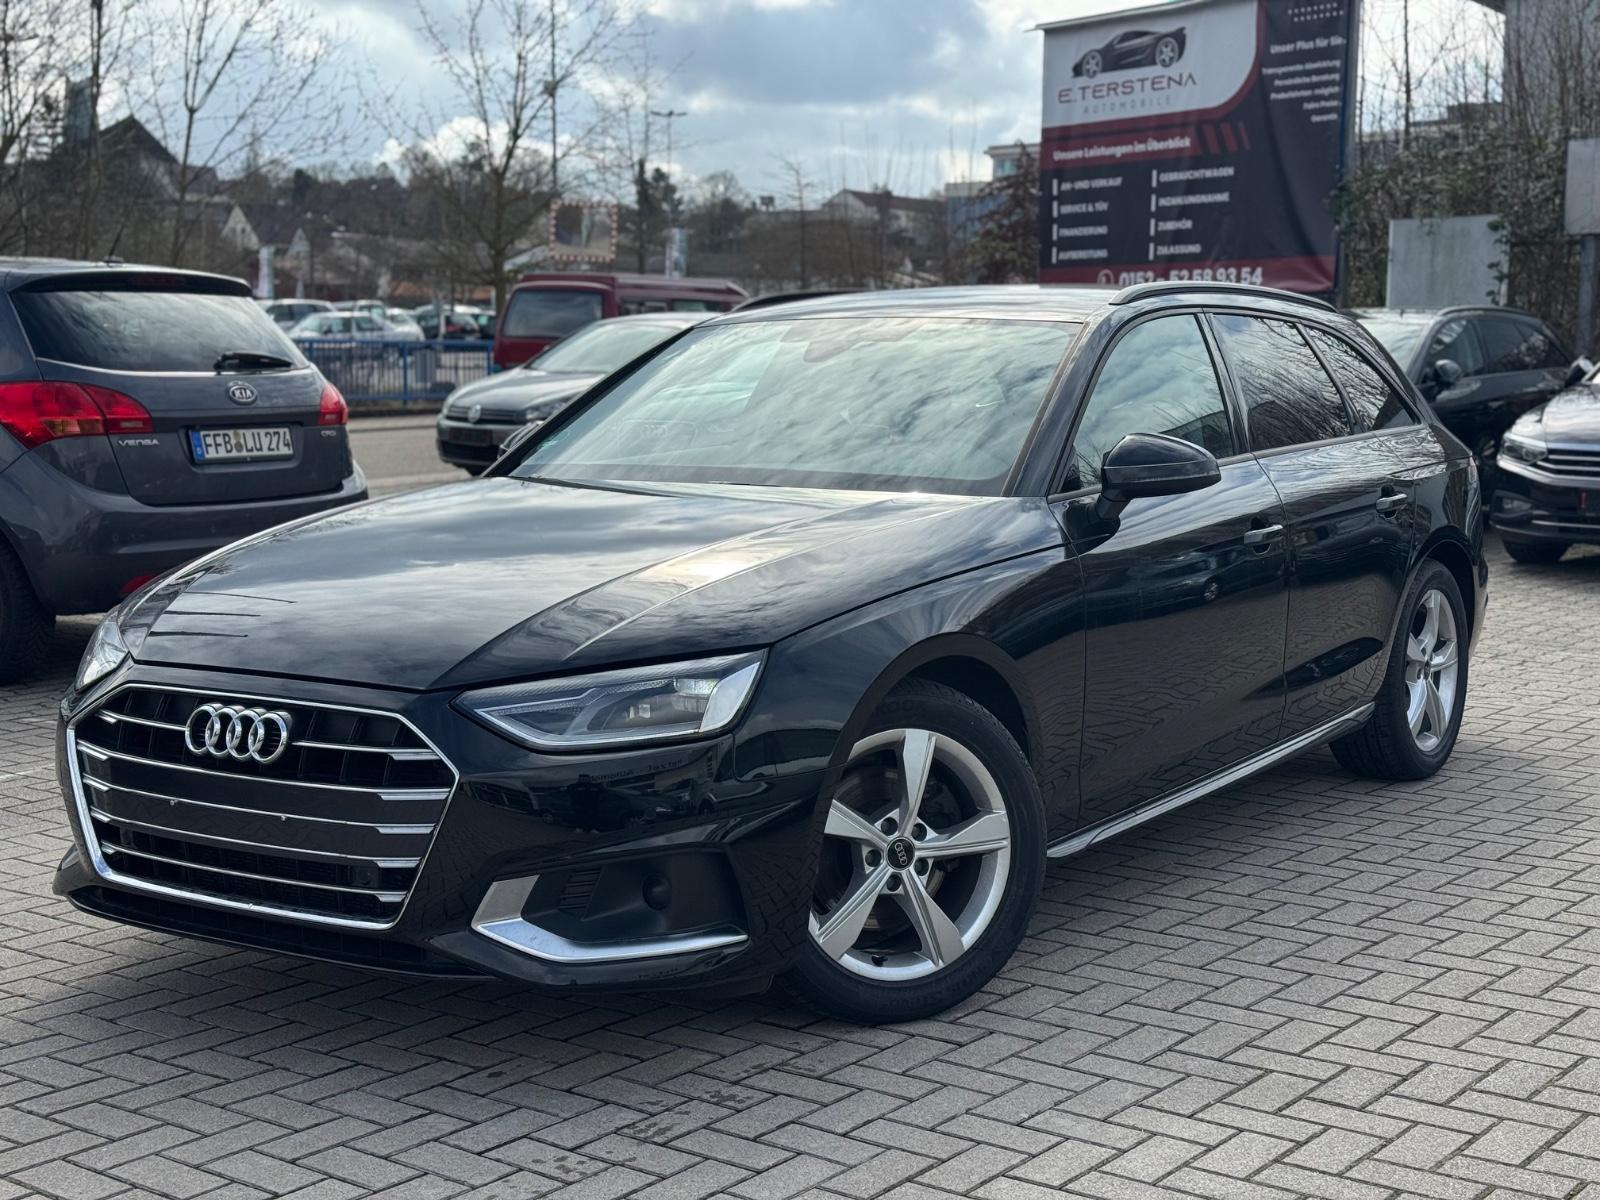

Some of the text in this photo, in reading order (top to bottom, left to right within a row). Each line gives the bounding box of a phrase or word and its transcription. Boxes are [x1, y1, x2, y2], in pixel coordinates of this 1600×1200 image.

[1216, 266, 1237, 285] 93
[1240, 265, 1263, 286] 54
[233, 388, 252, 399] KIA
[202, 433, 233, 455] FFB
[243, 432, 262, 453] LU
[264, 430, 291, 451] 274
